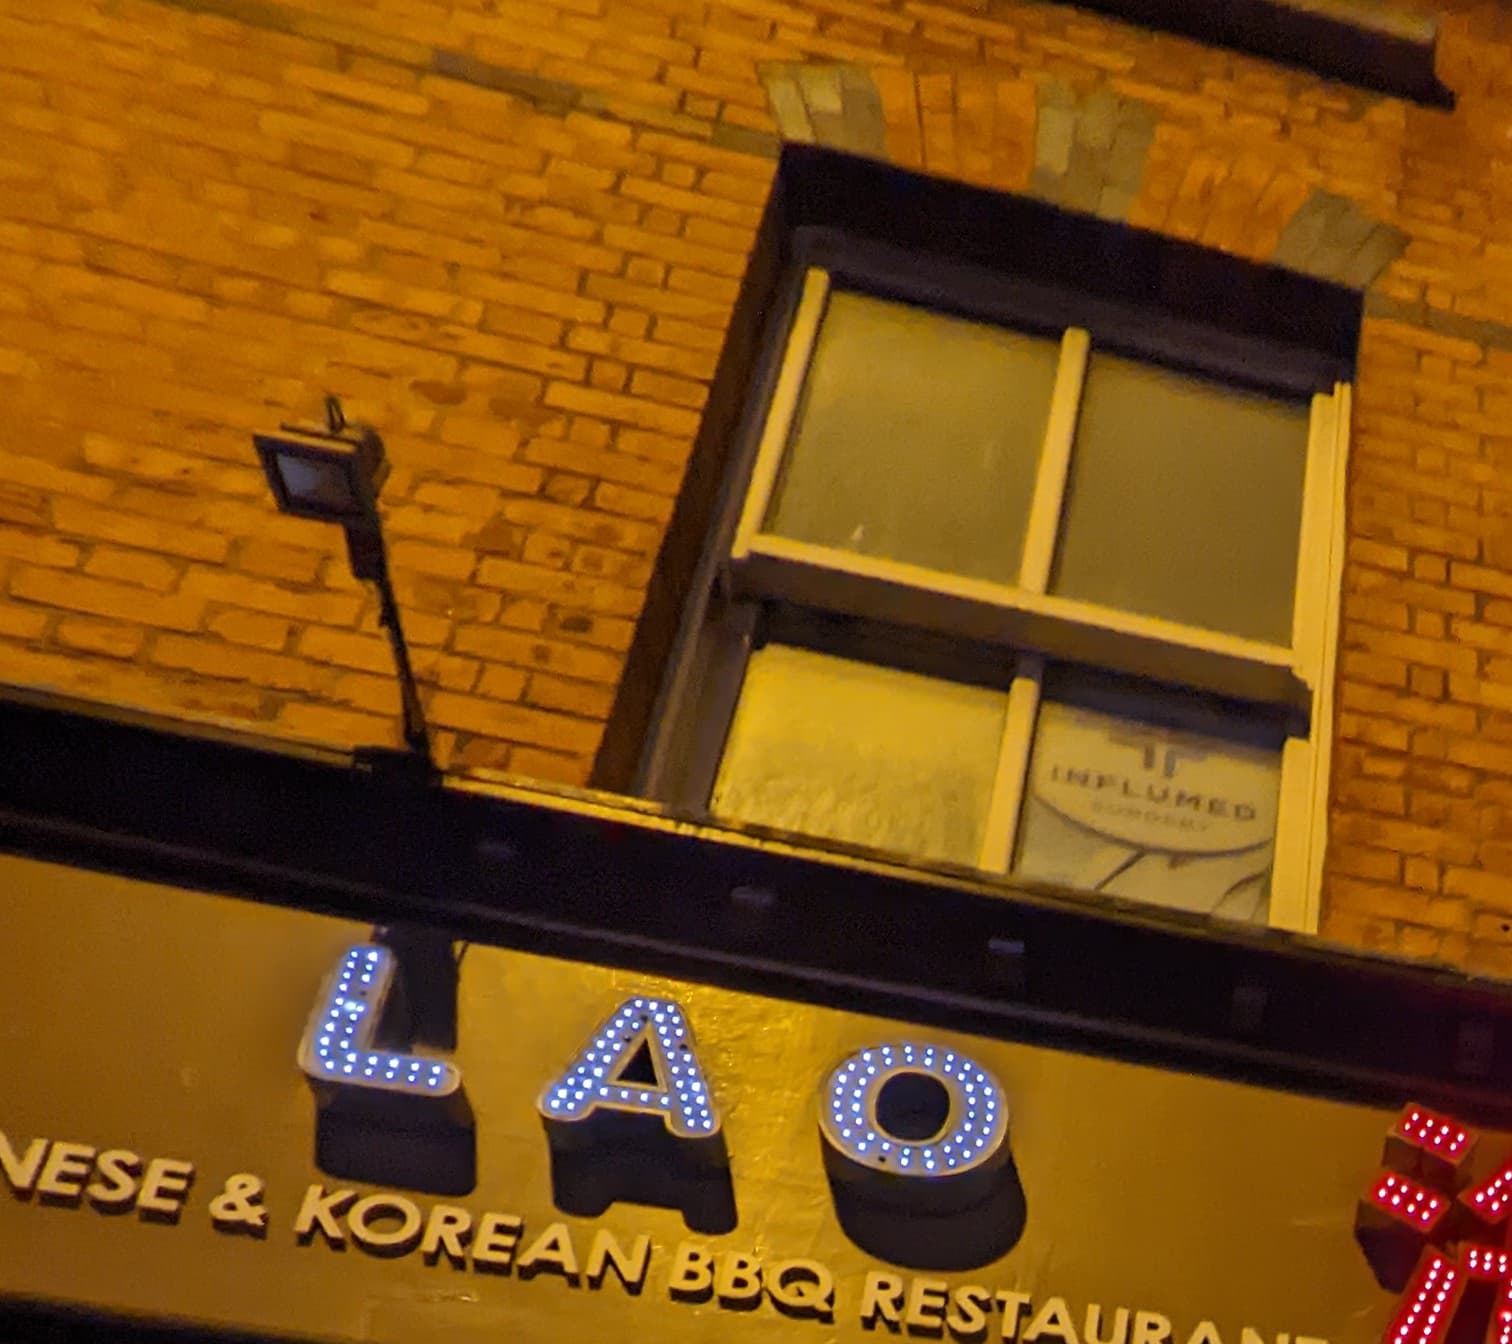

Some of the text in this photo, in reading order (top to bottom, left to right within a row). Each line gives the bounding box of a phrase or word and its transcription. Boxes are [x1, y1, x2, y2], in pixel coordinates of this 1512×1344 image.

[298, 944, 1009, 1177] LAO
[0, 1130, 196, 1214] NESE
[208, 1172, 268, 1227] &
[296, 1184, 651, 1284] KOREAN
[671, 1247, 835, 1314] BBQ
